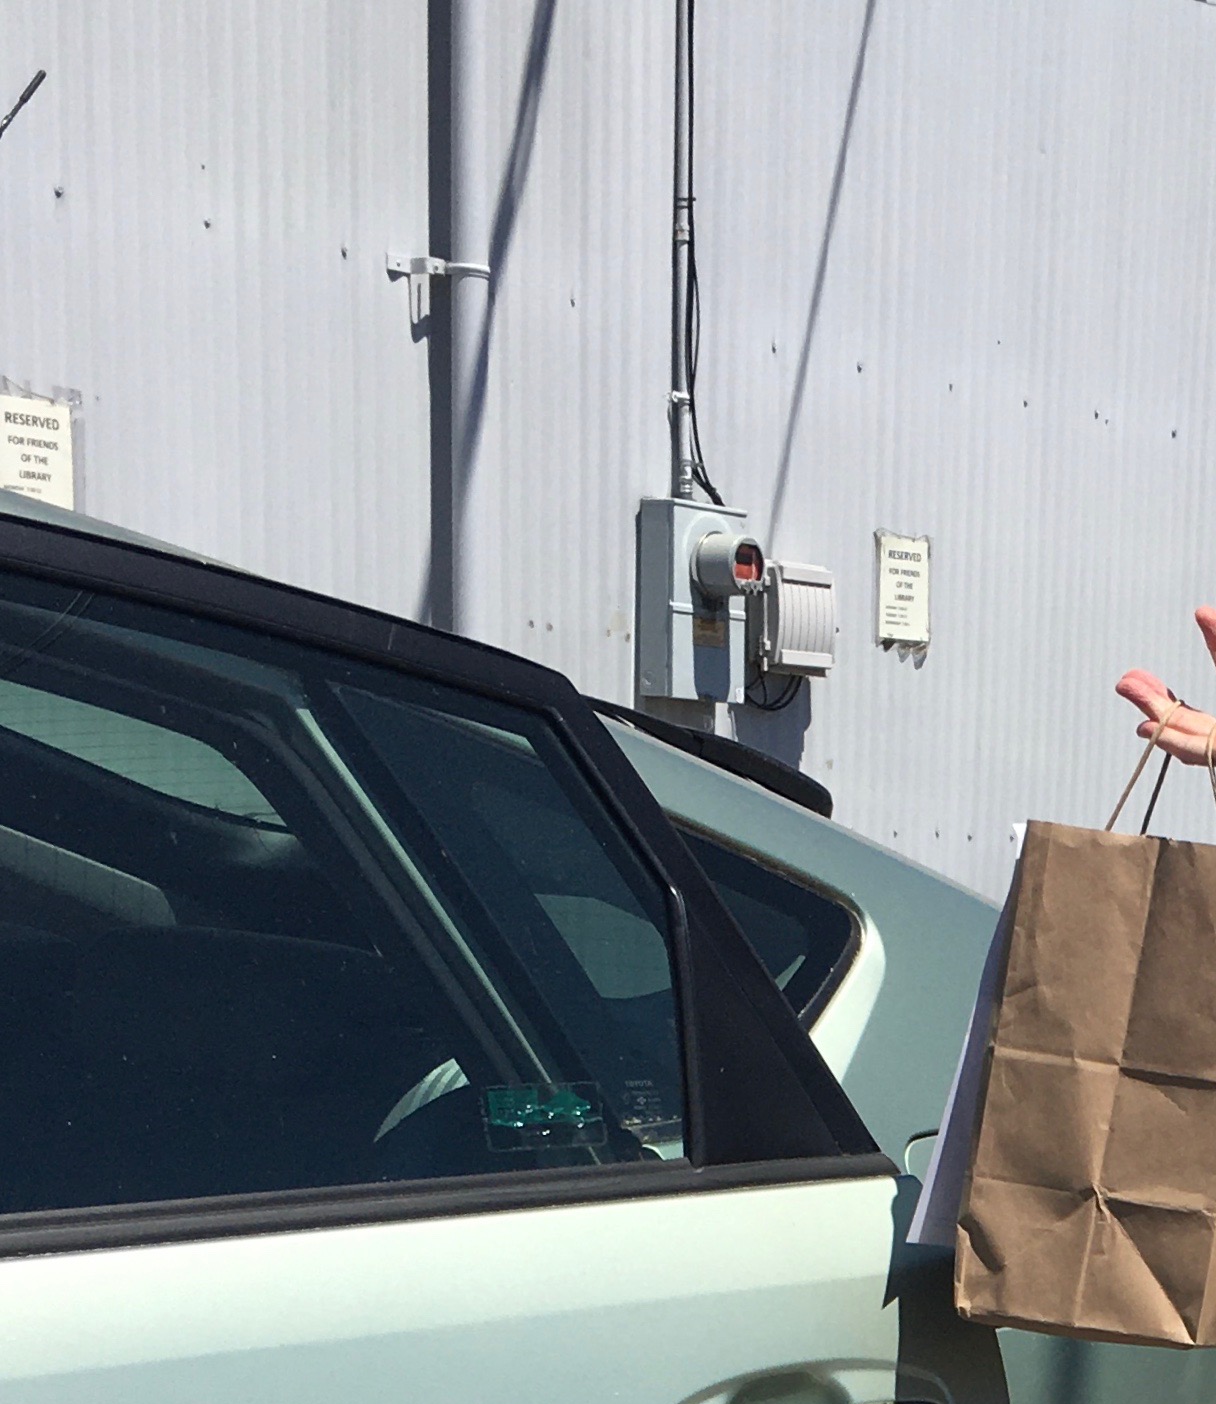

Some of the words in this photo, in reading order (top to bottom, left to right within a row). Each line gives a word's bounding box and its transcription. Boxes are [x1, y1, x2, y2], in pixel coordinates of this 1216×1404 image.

[5, 411, 59, 430] RESERVED
[8, 435, 25, 446] FOR
[26, 438, 59, 451] FRIENDS
[20, 453, 32, 463] OF
[33, 455, 48, 466] THE
[19, 469, 52, 482] LIBRARY
[888, 550, 922, 562] RESERVED
[904, 582, 913, 590] THE
[895, 594, 914, 602] LIBRARY
